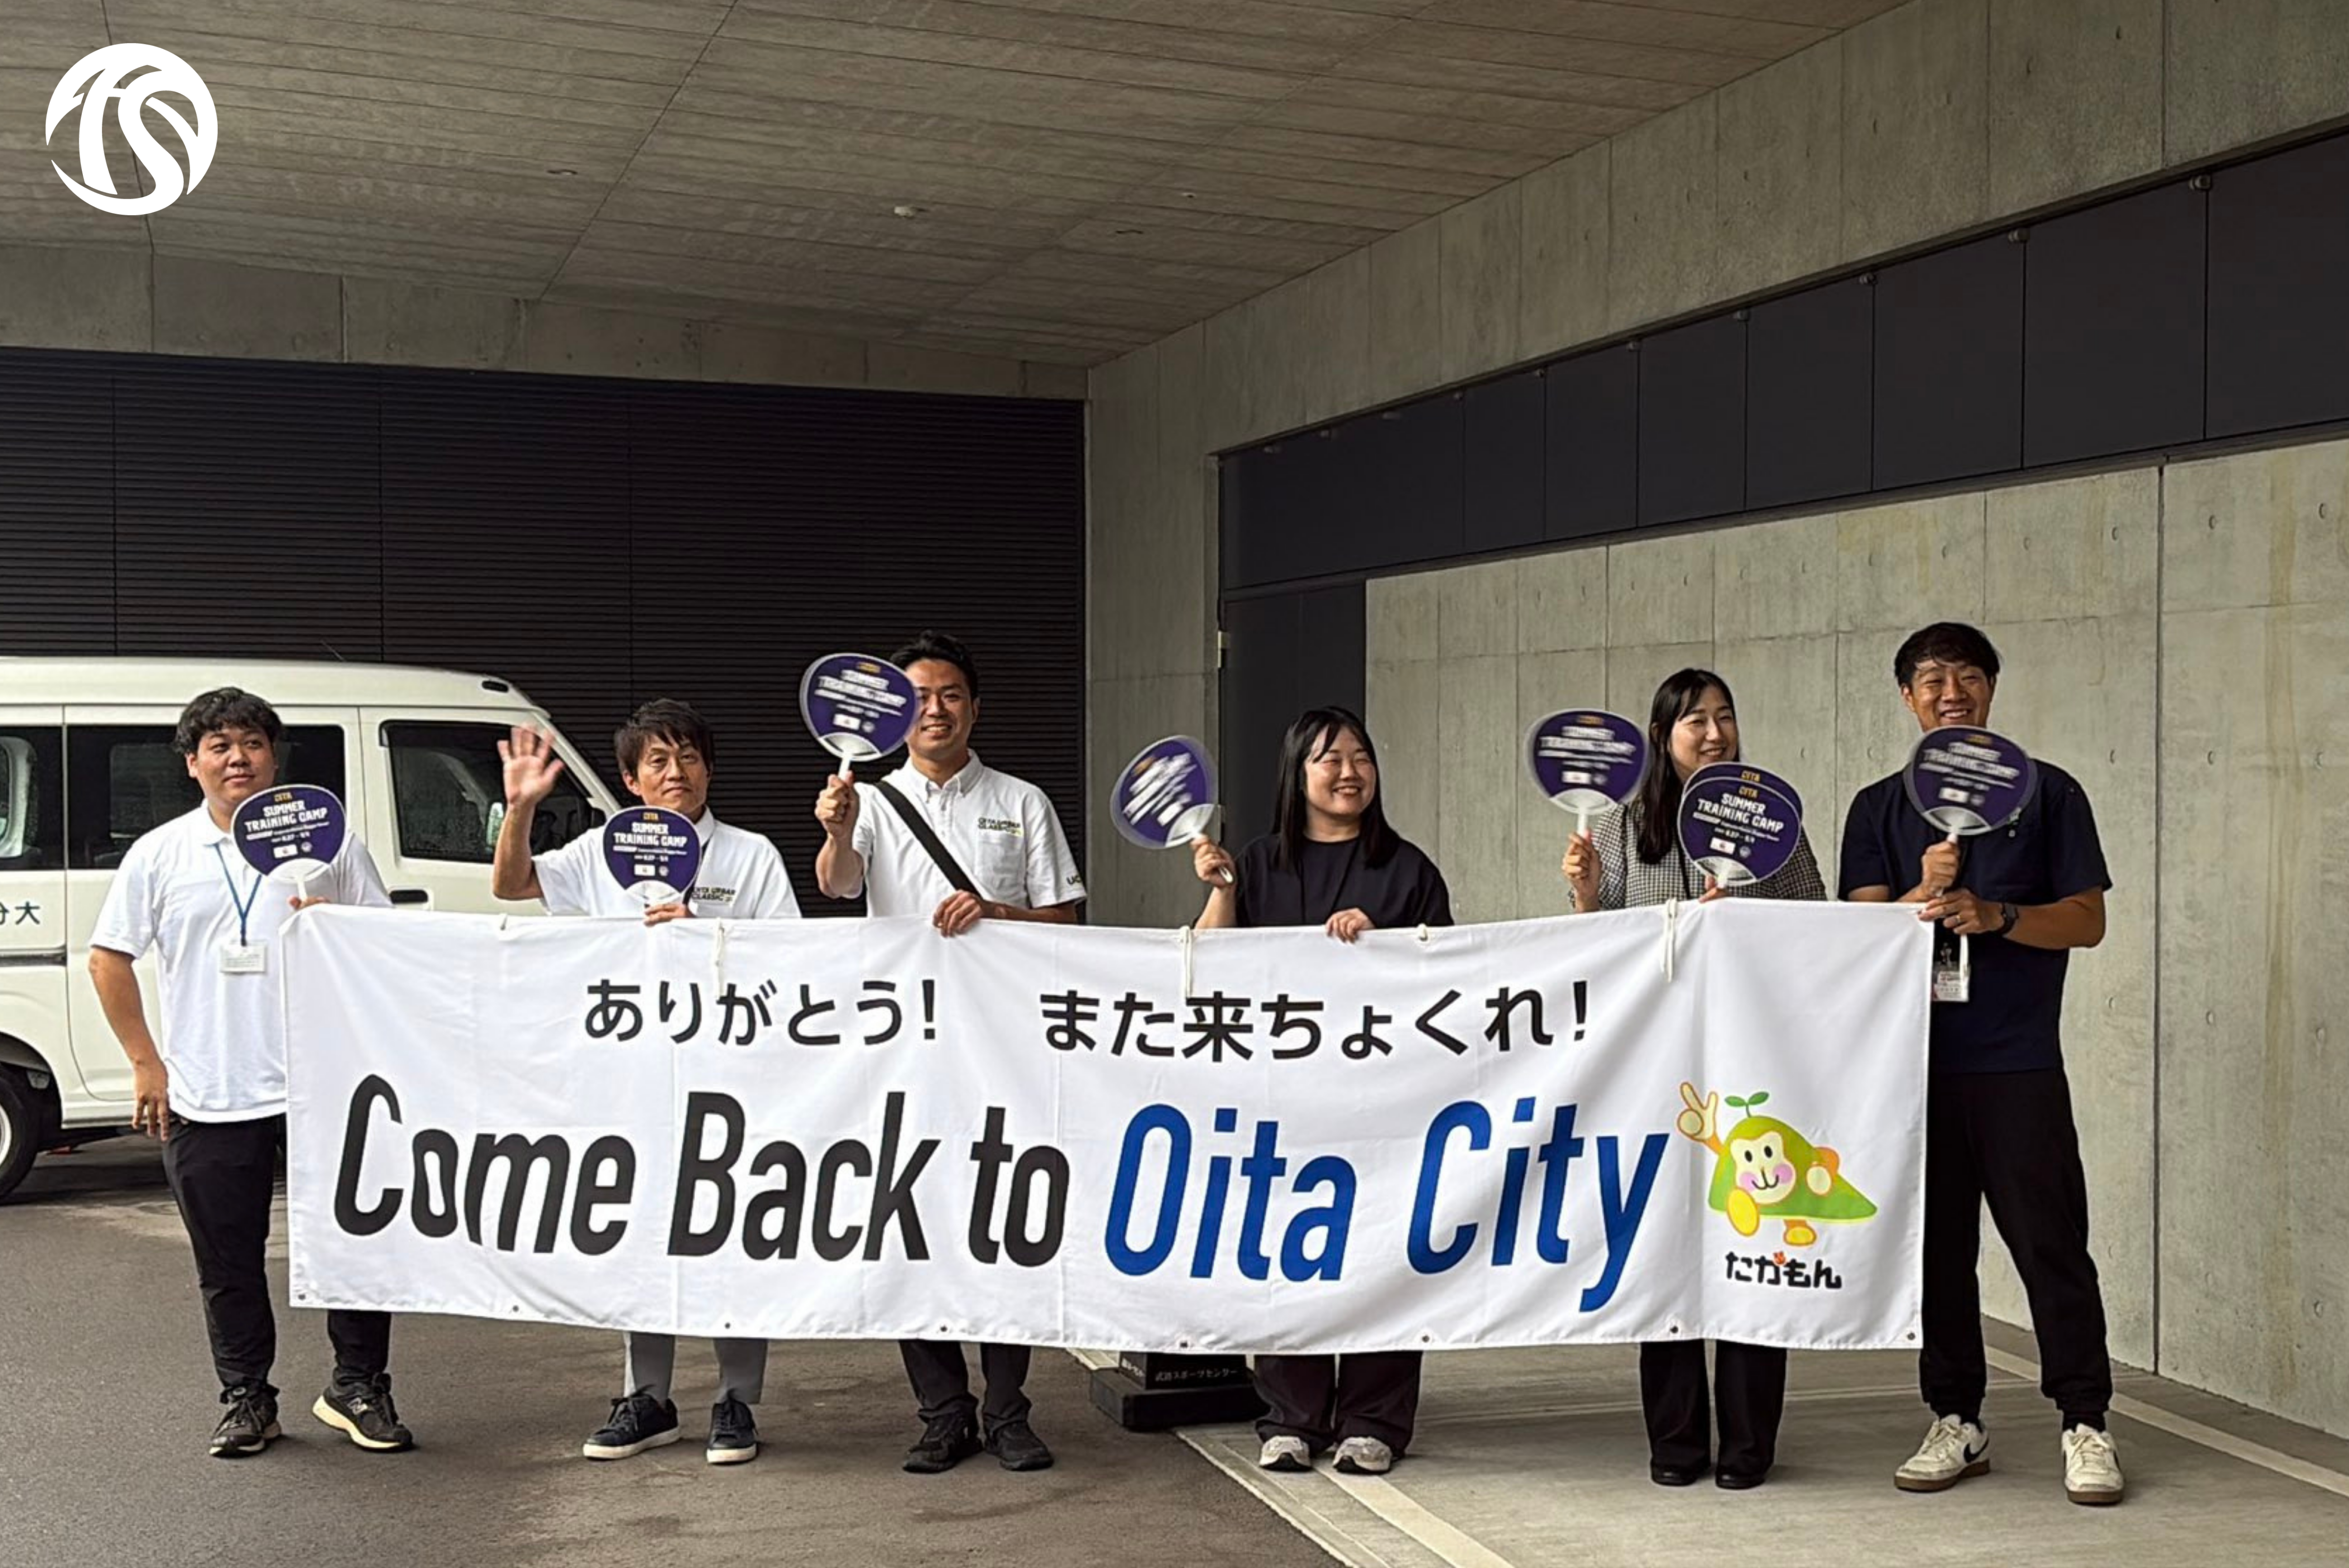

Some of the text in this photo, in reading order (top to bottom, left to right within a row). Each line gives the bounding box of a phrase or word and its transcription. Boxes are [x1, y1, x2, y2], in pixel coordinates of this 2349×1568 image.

[263, 800, 306, 817] SUMMER
[1721, 792, 1766, 815] SUMMER
[244, 813, 297, 832] TRAINING
[298, 807, 328, 822] CAMP
[632, 822, 669, 834] SUMMER
[1697, 798, 1751, 824] TRAINING
[1752, 815, 1784, 834] CAMP
[614, 832, 688, 848] TRAINING CAMP
[585, 978, 1588, 1063] ありがとう！ また来ちょくれ！
[333, 1073, 1671, 1313] Come Back to Oita City
